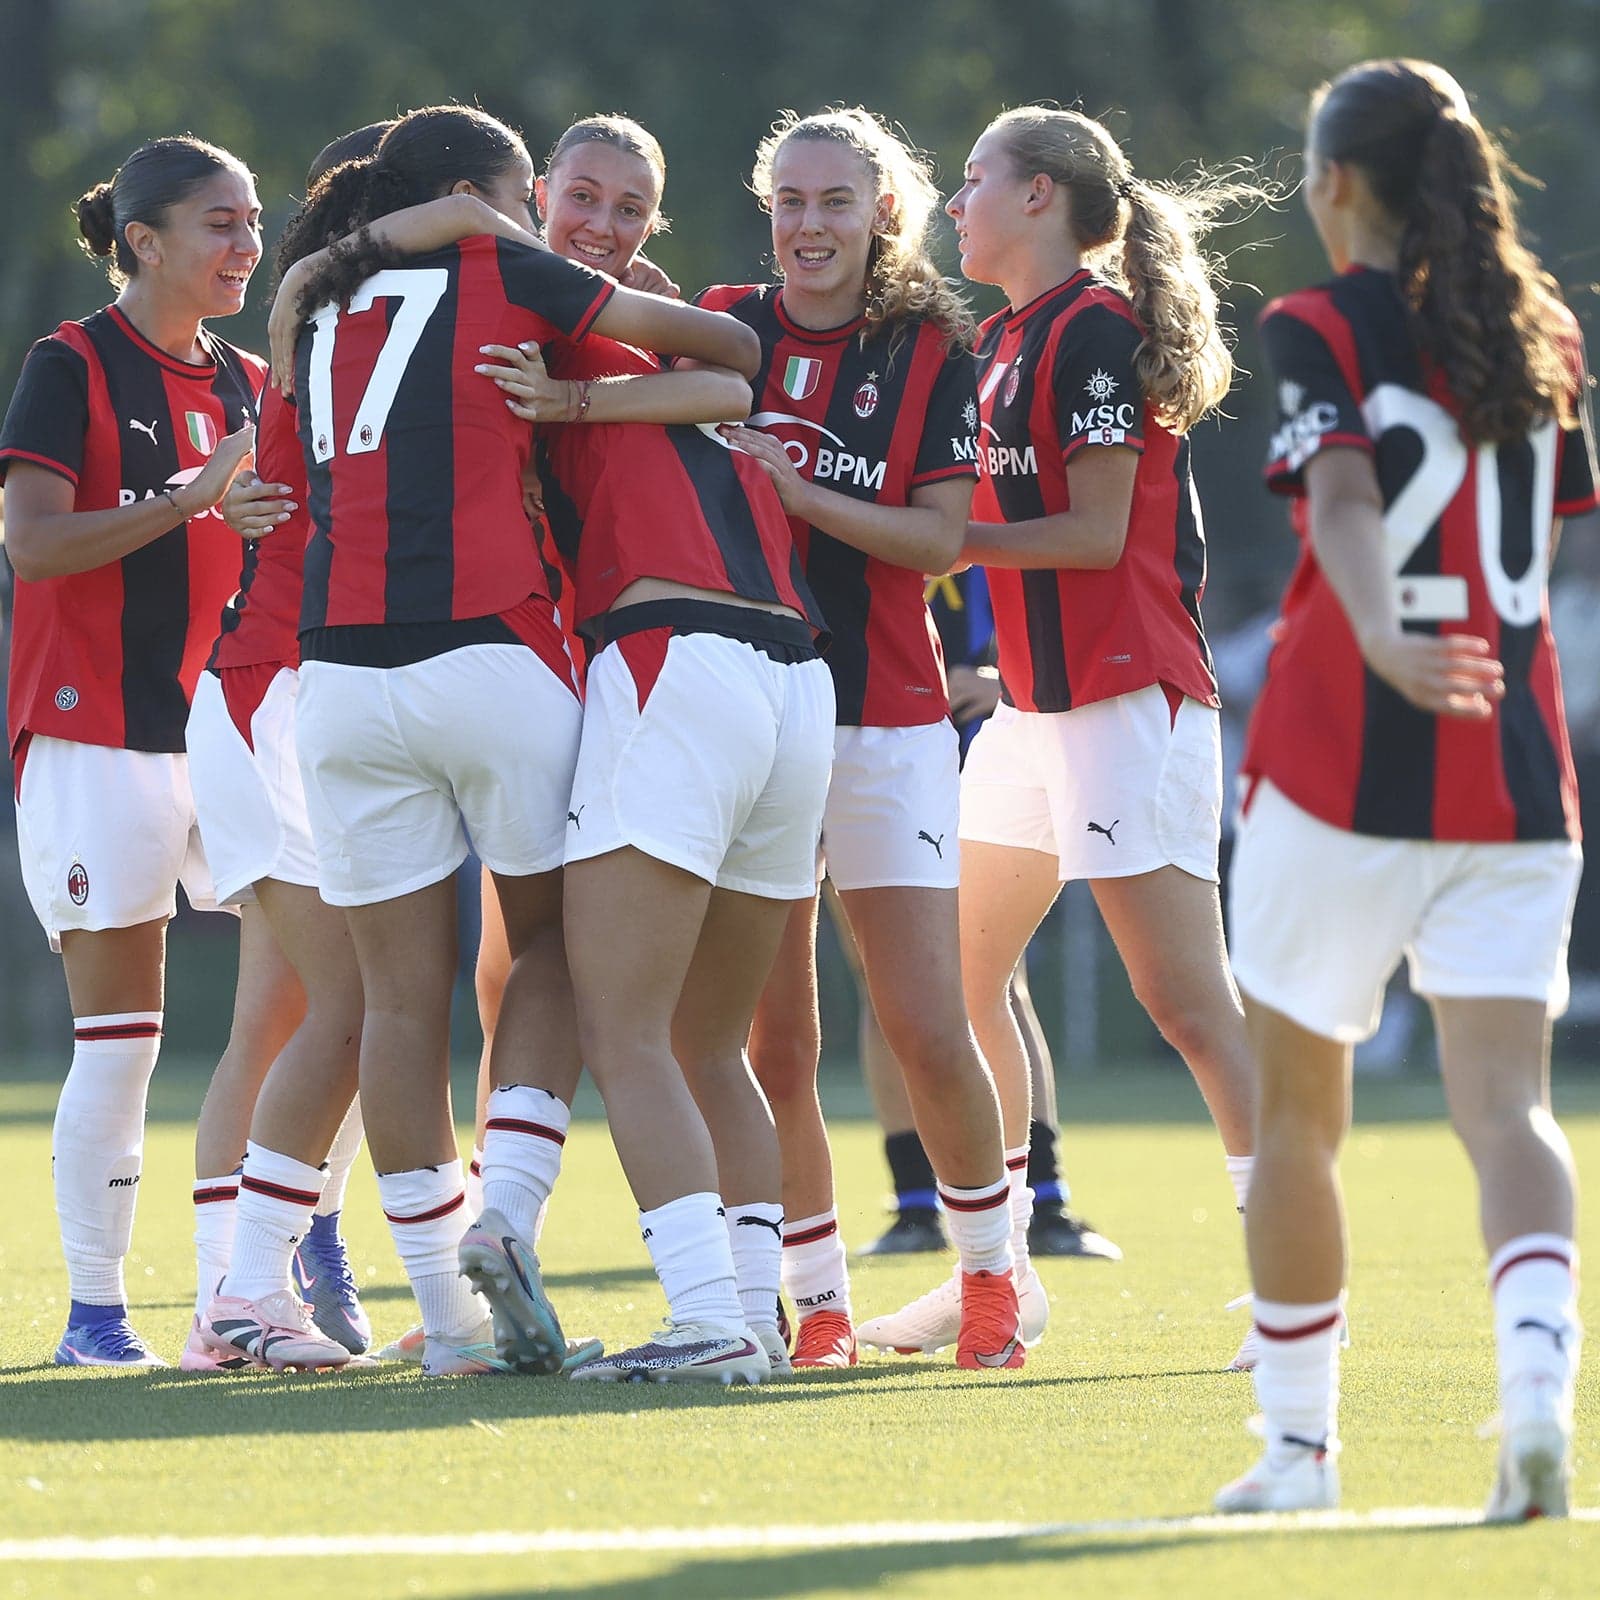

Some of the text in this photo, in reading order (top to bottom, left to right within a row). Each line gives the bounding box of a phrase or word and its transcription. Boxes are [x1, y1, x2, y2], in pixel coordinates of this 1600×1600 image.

[307, 268, 448, 464] 17
[1070, 403, 1135, 436] MSC
[1101, 426, 1113, 445] 6
[814, 448, 887, 490] BPM
[988, 446, 1039, 476] BPM
[1360, 384, 1558, 628] 20
